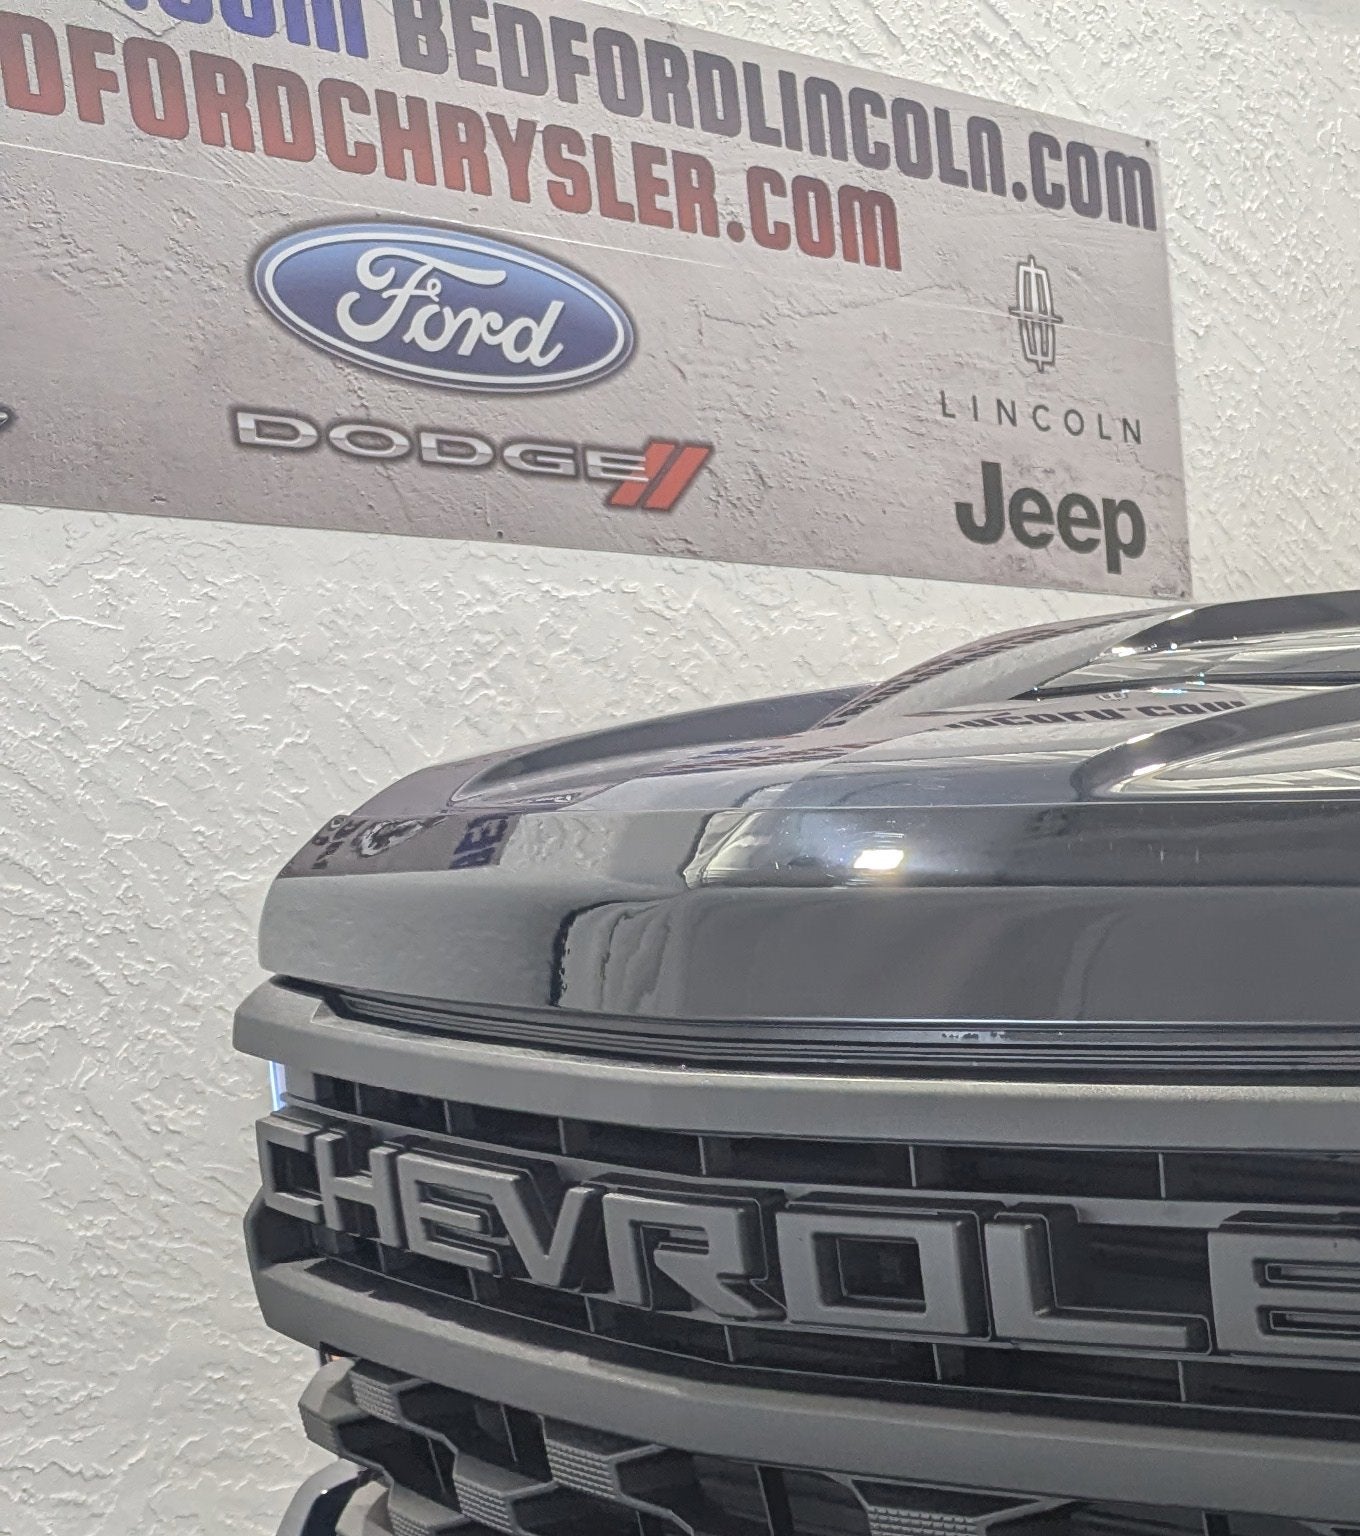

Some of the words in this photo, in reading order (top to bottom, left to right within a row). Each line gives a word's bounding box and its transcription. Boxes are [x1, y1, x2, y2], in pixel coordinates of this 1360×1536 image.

[336, 246, 567, 368] Ford
[236, 411, 650, 483] DODGE
[940, 389, 1142, 445] LINCOLN
[954, 460, 1147, 575] Jeep
